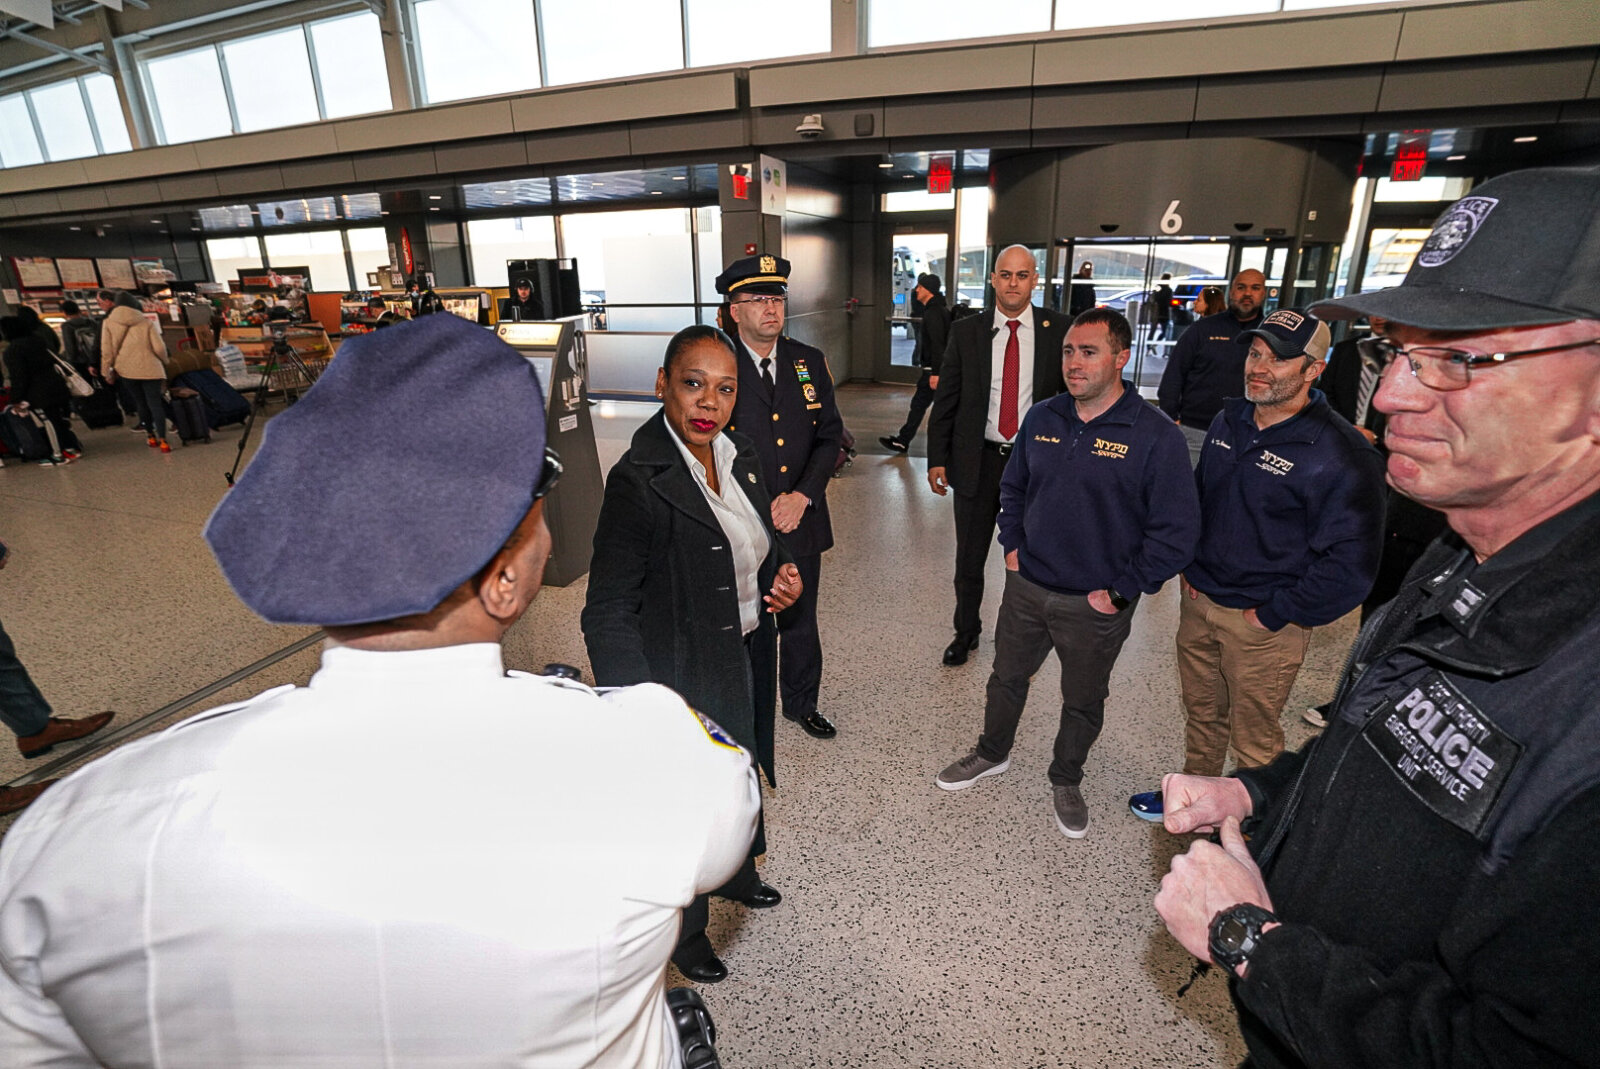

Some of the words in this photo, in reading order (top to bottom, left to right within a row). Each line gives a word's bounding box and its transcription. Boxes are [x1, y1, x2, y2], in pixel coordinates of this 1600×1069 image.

[930, 176, 951, 192] EXIT
[1160, 199, 1183, 234] 6
[1093, 438, 1129, 454] NYPD
[1260, 450, 1294, 471] NYPD
[1395, 687, 1495, 790] POLICE
[1397, 753, 1421, 780] UNIT
[1423, 754, 1470, 801] SERVICE
